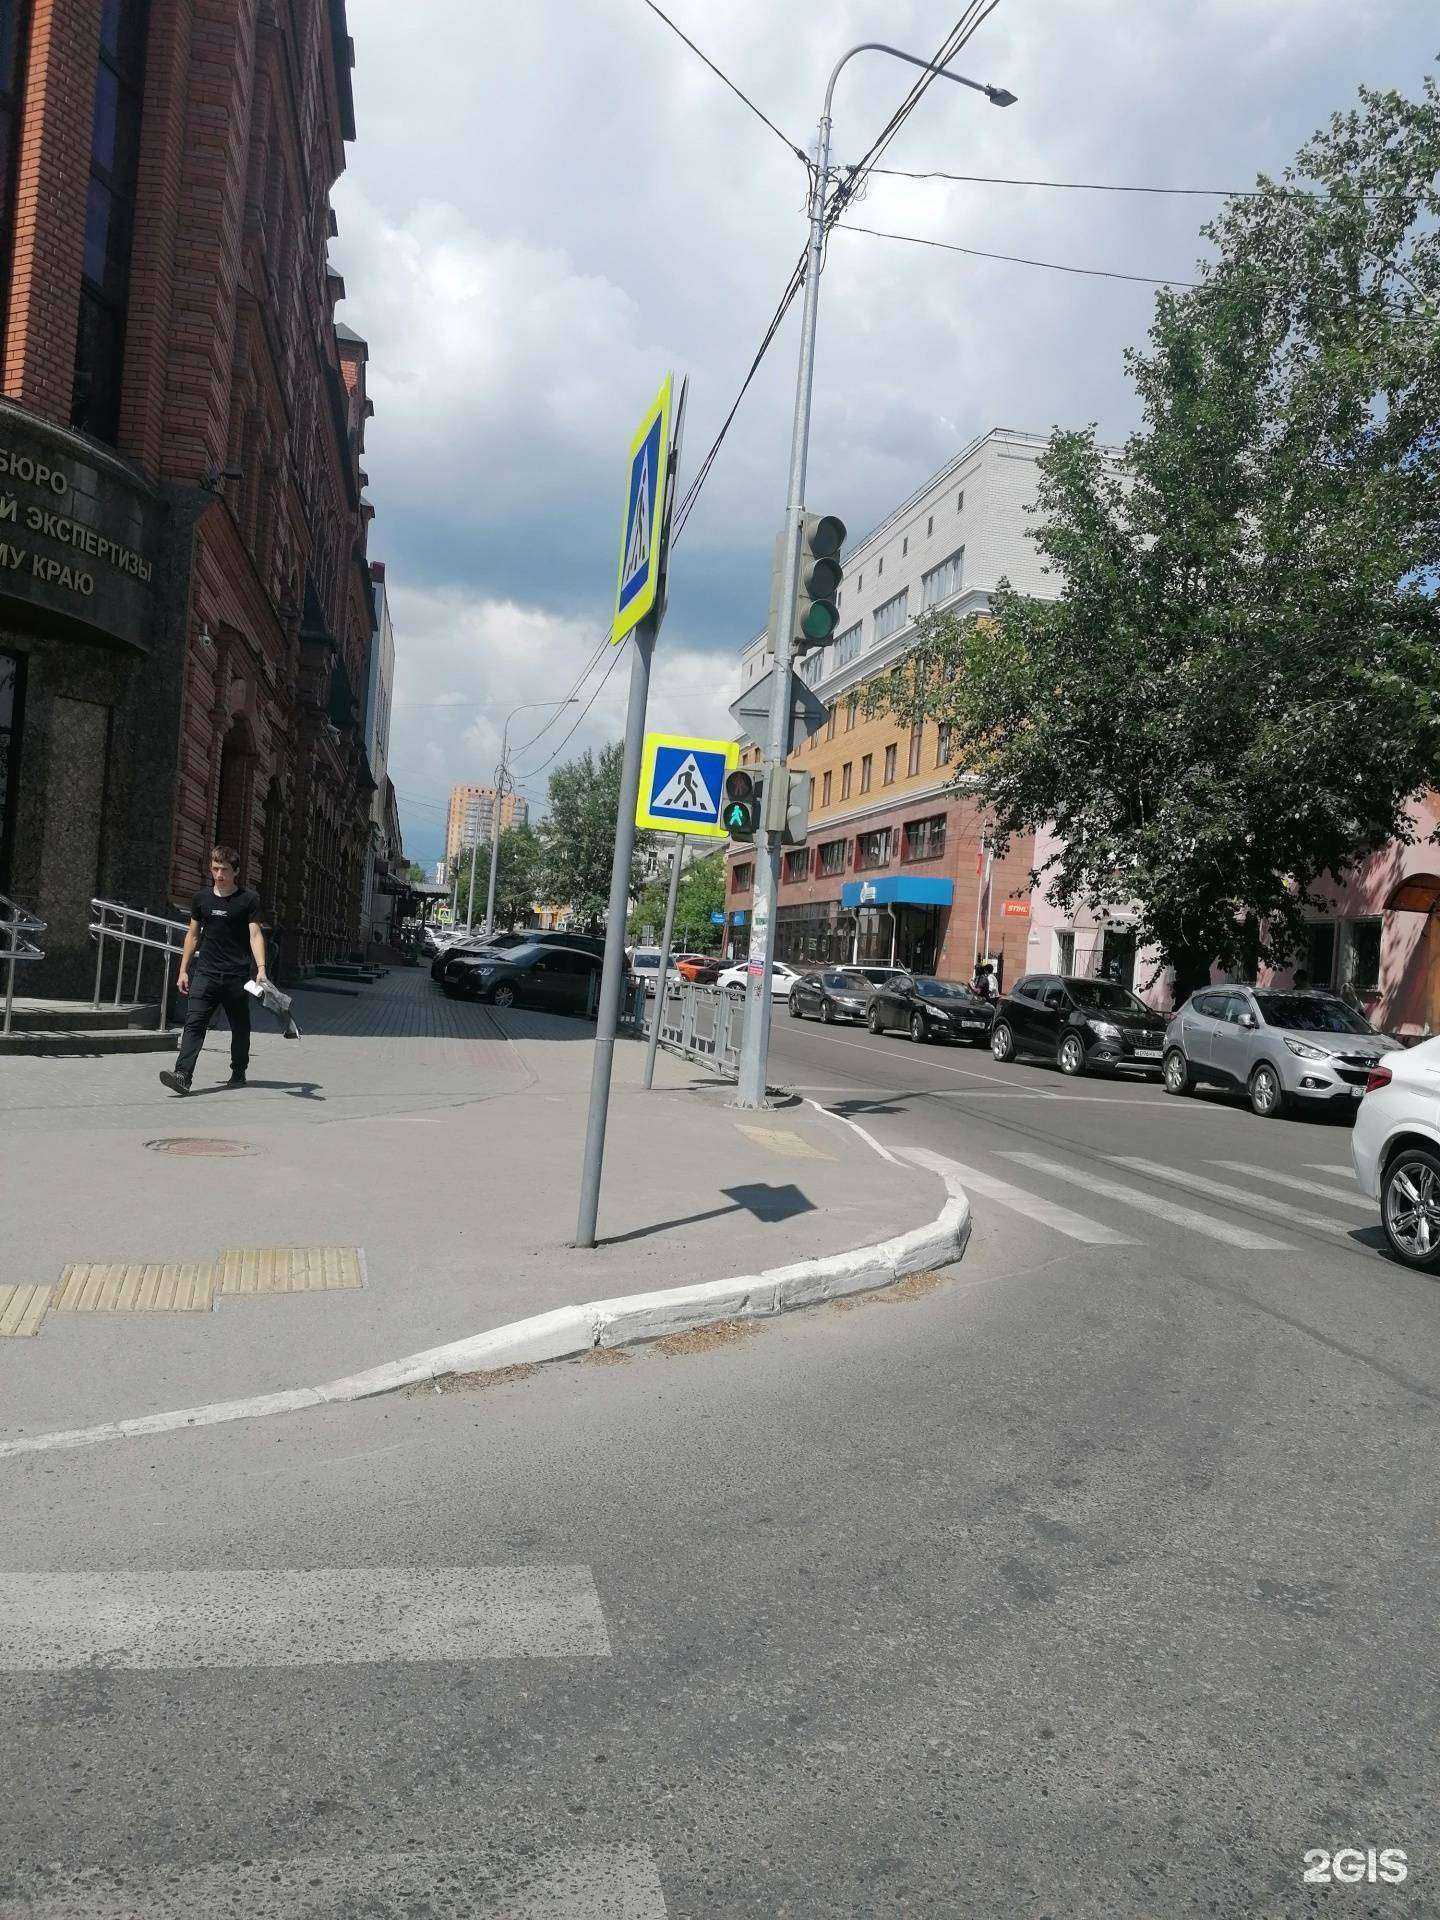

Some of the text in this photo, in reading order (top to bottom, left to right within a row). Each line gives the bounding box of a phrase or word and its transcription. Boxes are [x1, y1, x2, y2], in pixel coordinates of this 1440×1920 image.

[26, 506, 152, 583] ЭКСПЕРТИЗЫ
[32, 554, 94, 595] КРАЮ
[1007, 904, 1028, 913] STIHL
